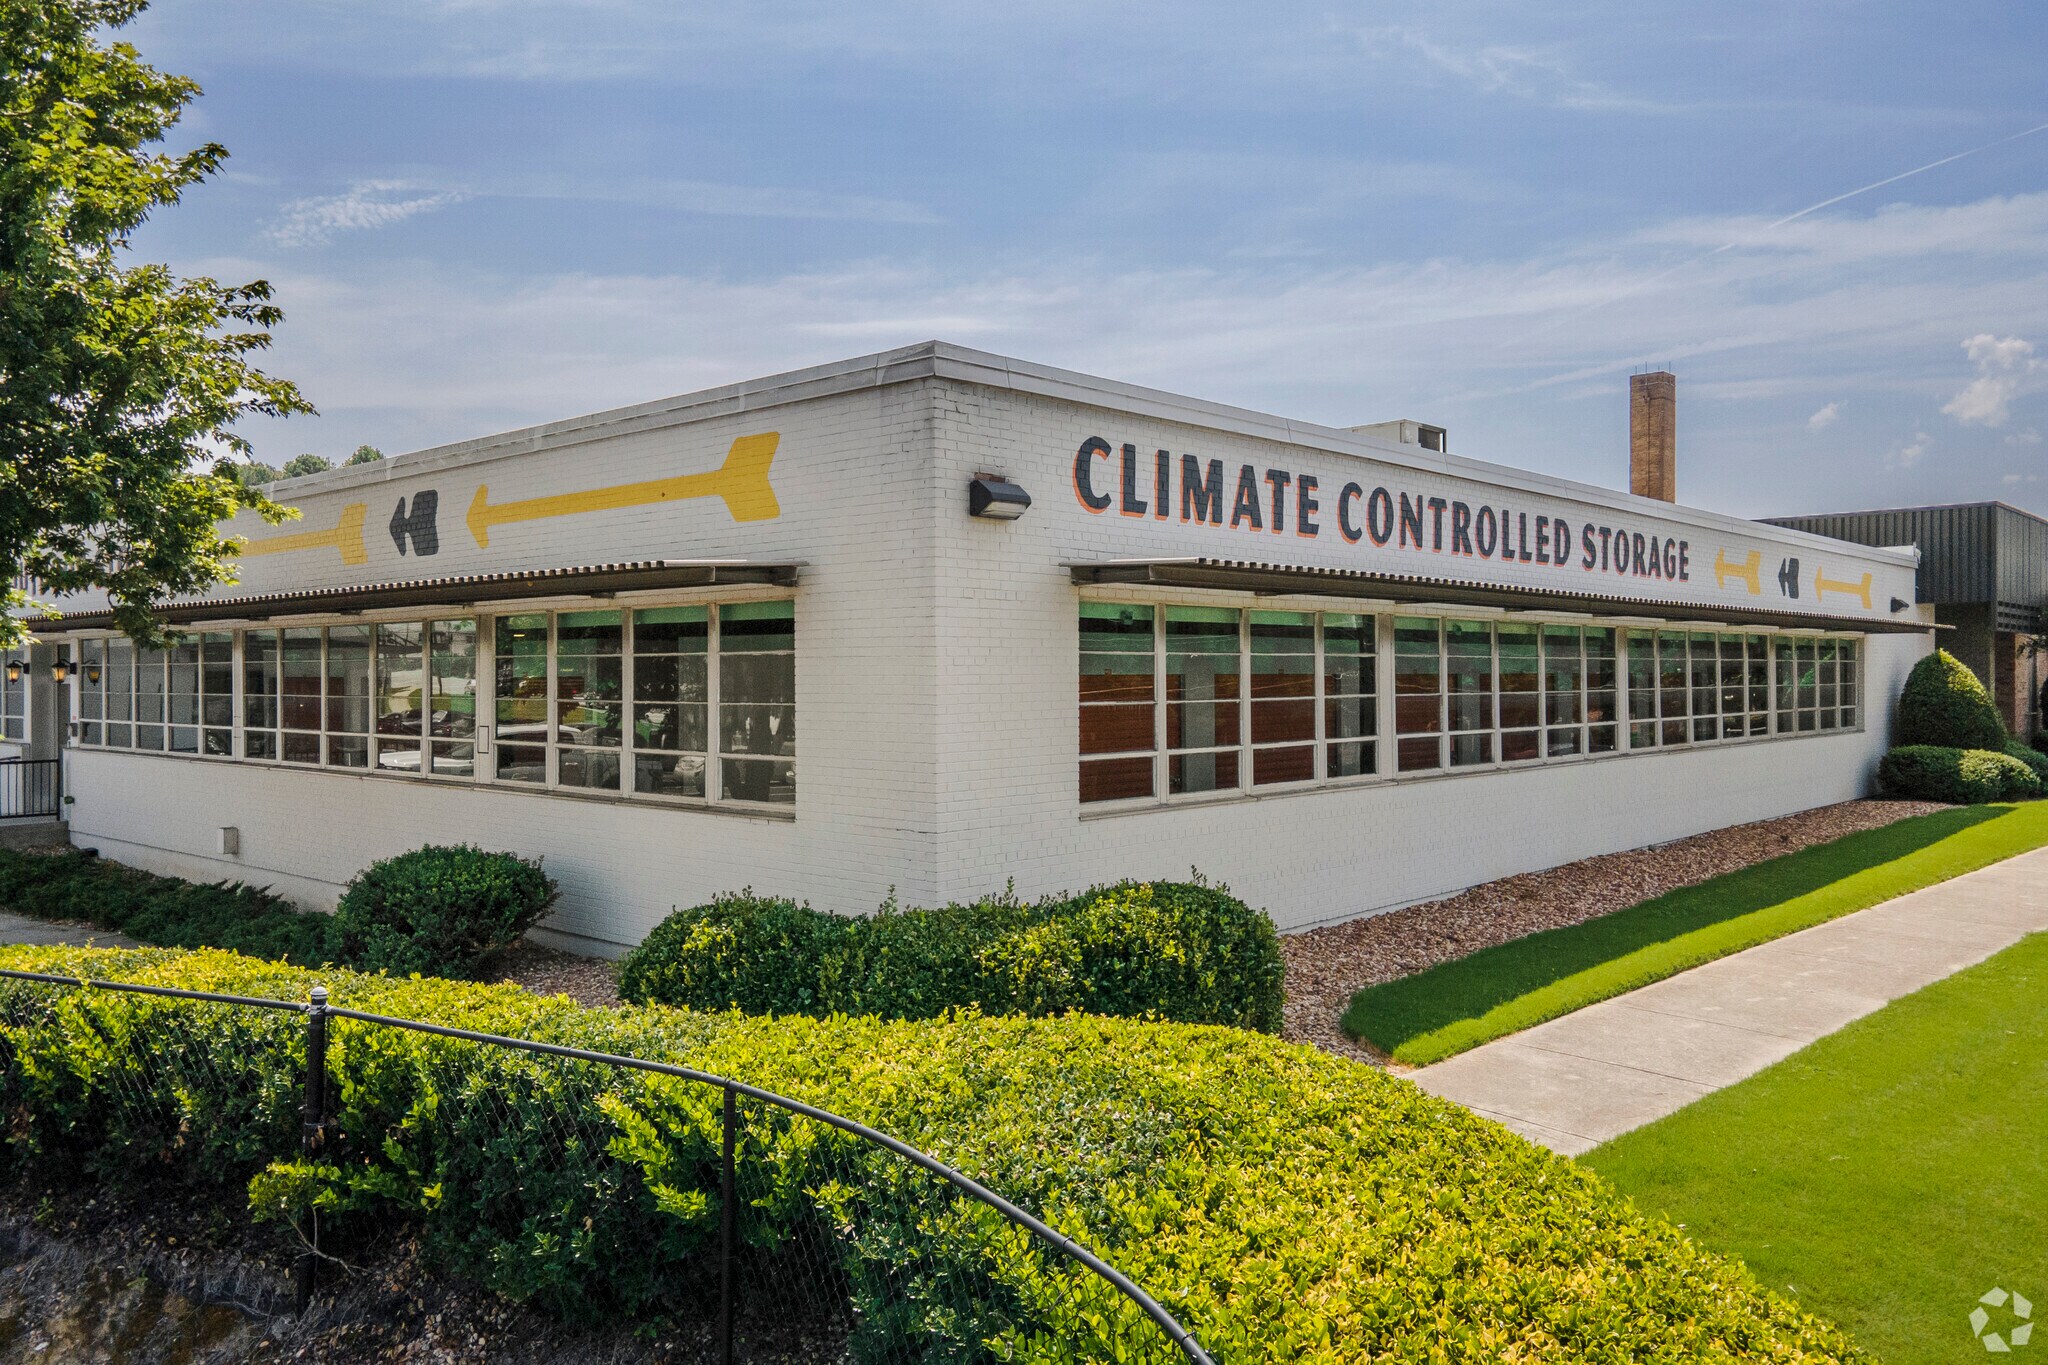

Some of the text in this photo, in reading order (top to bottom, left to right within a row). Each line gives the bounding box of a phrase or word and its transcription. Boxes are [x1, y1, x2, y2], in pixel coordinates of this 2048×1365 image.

[1073, 436, 1690, 582] CLIMATE CONTROLLED STORAGE
